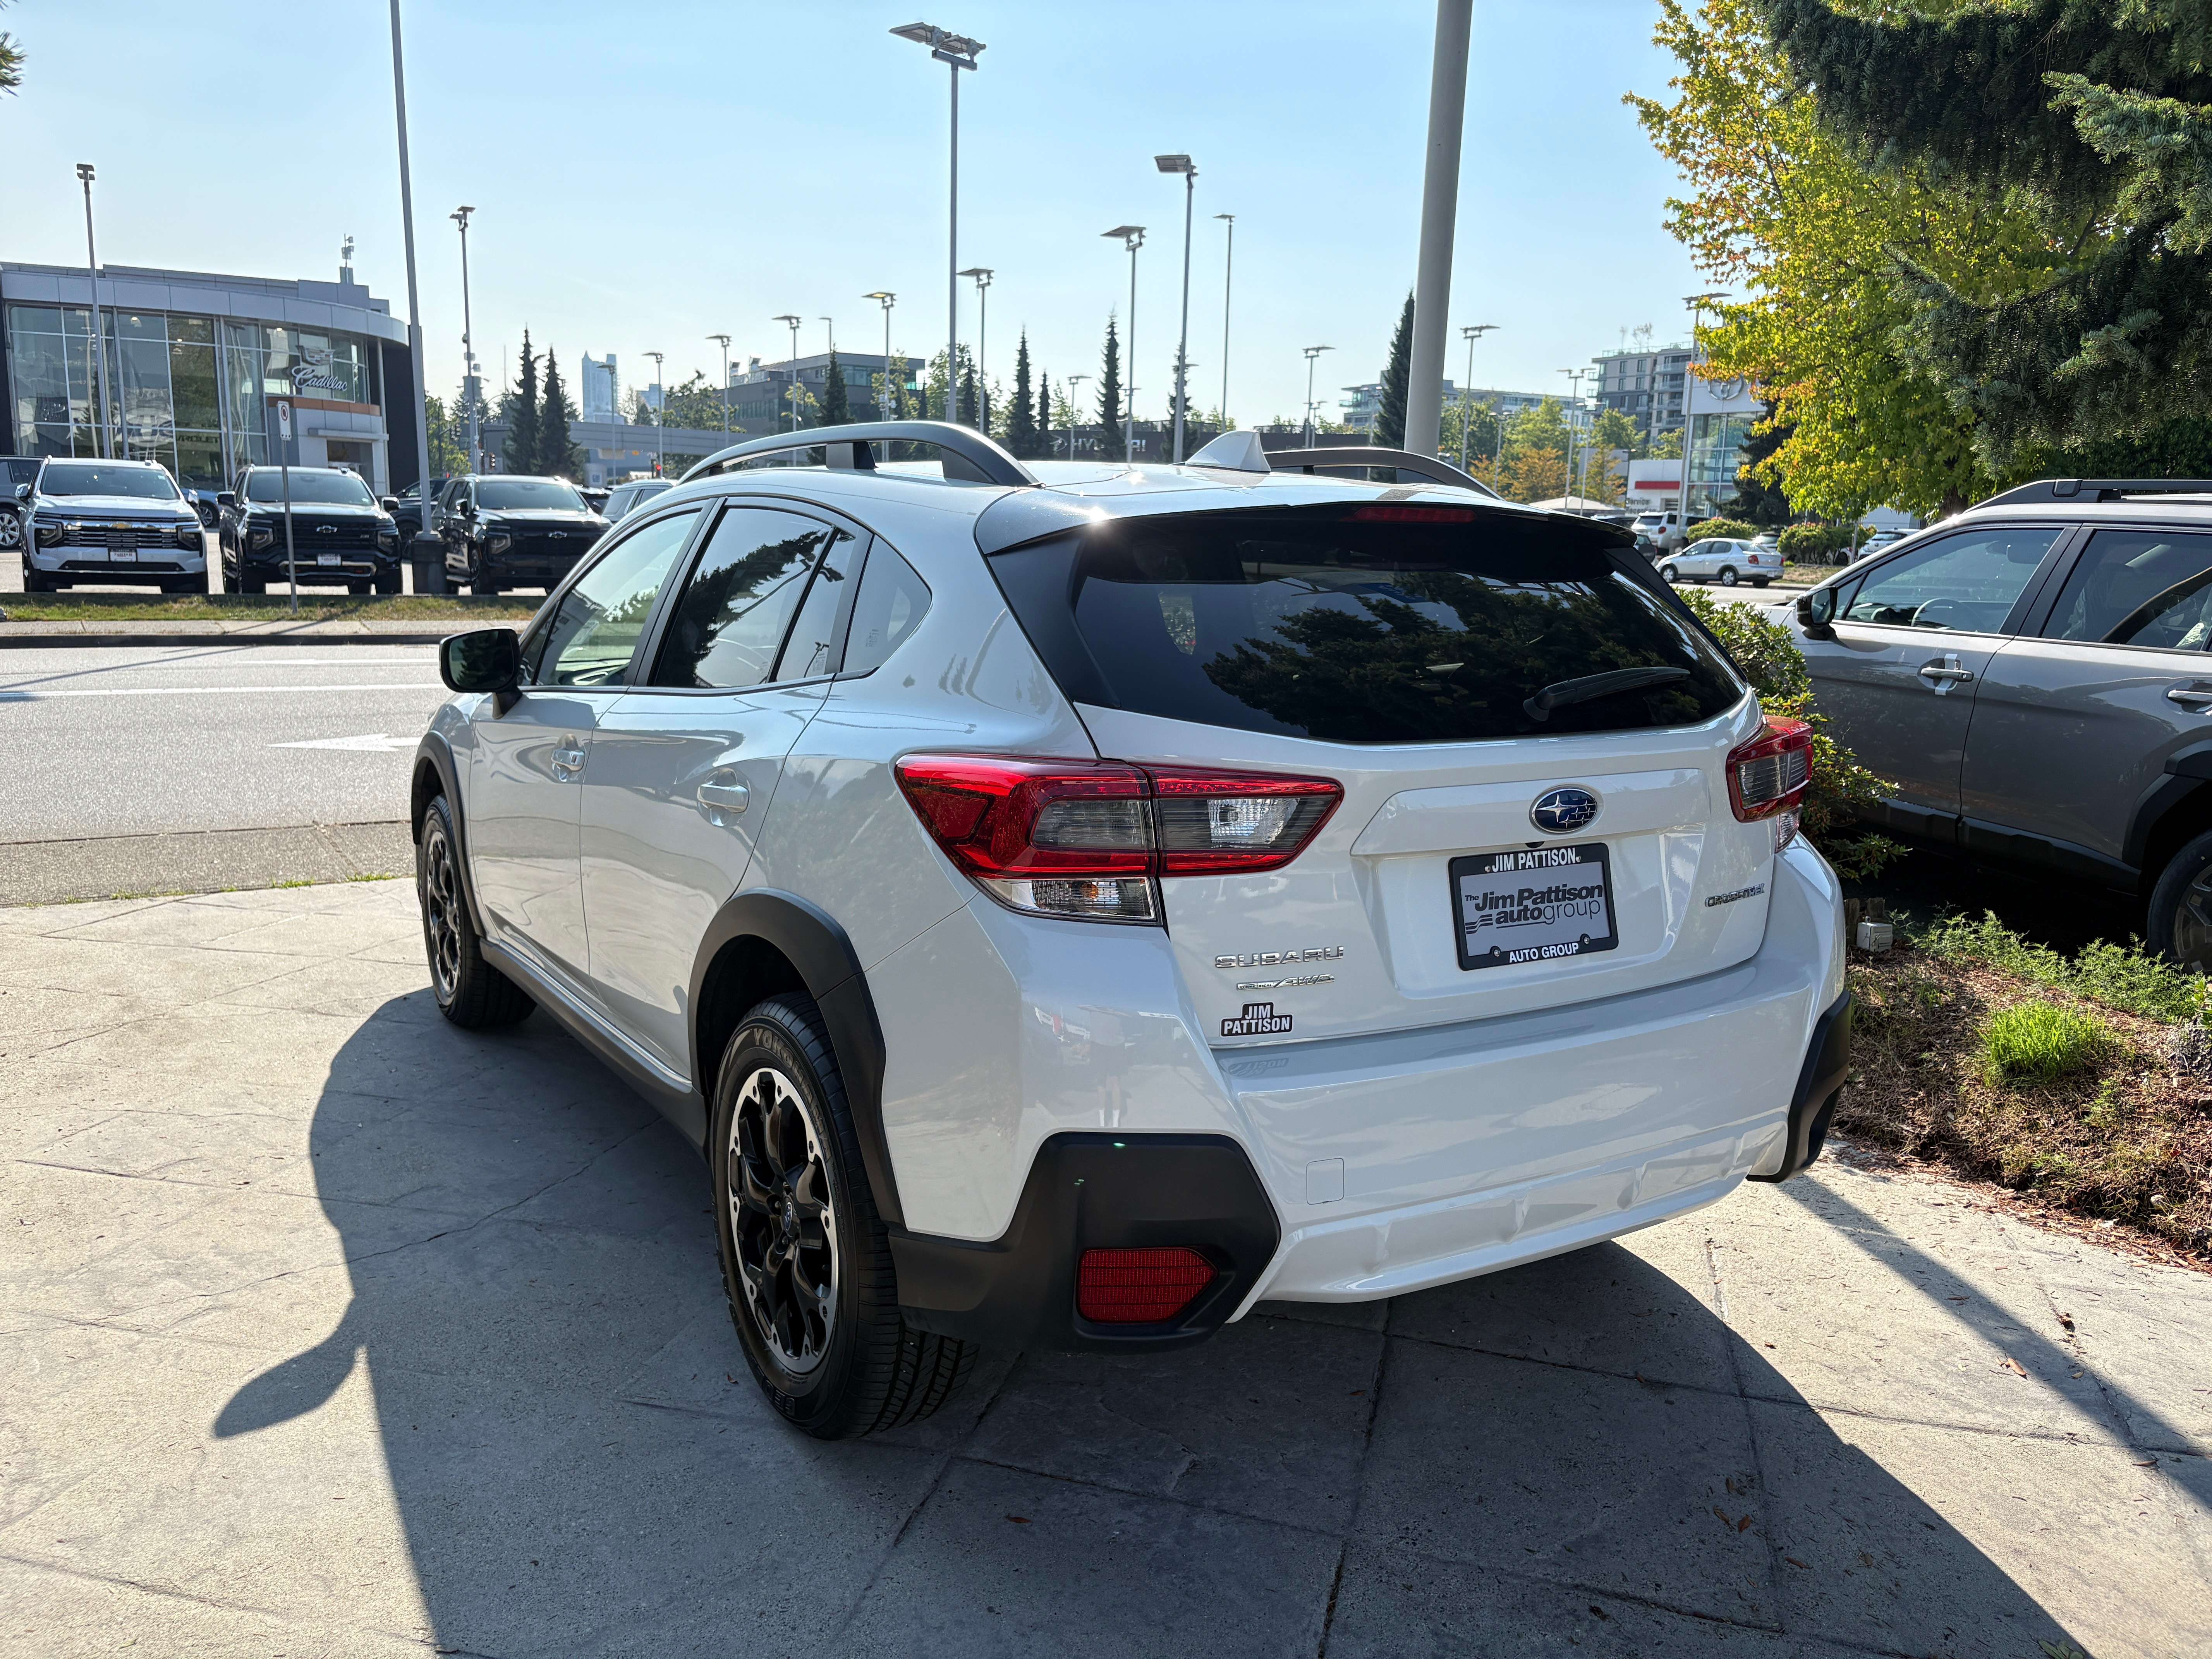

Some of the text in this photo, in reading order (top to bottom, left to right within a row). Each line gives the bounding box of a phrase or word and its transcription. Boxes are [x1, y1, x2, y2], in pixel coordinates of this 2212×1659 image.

[292, 366, 347, 392] Cadillac
[1072, 438, 1146, 452] HYAI
[1492, 848, 1575, 872] JIM PATTISON
[1475, 891, 1515, 911] Jim
[1517, 883, 1602, 907] Pattison
[1705, 883, 1765, 907] CROSSTREK
[1215, 946, 1344, 968] SUBARU
[1509, 943, 1579, 963] AUTO GROUP
[1274, 974, 1336, 988] AWD
[1245, 1005, 1271, 1019] JIM
[1224, 1017, 1290, 1034] PATTISON
[754, 1028, 832, 1163] YOKOHAMA
